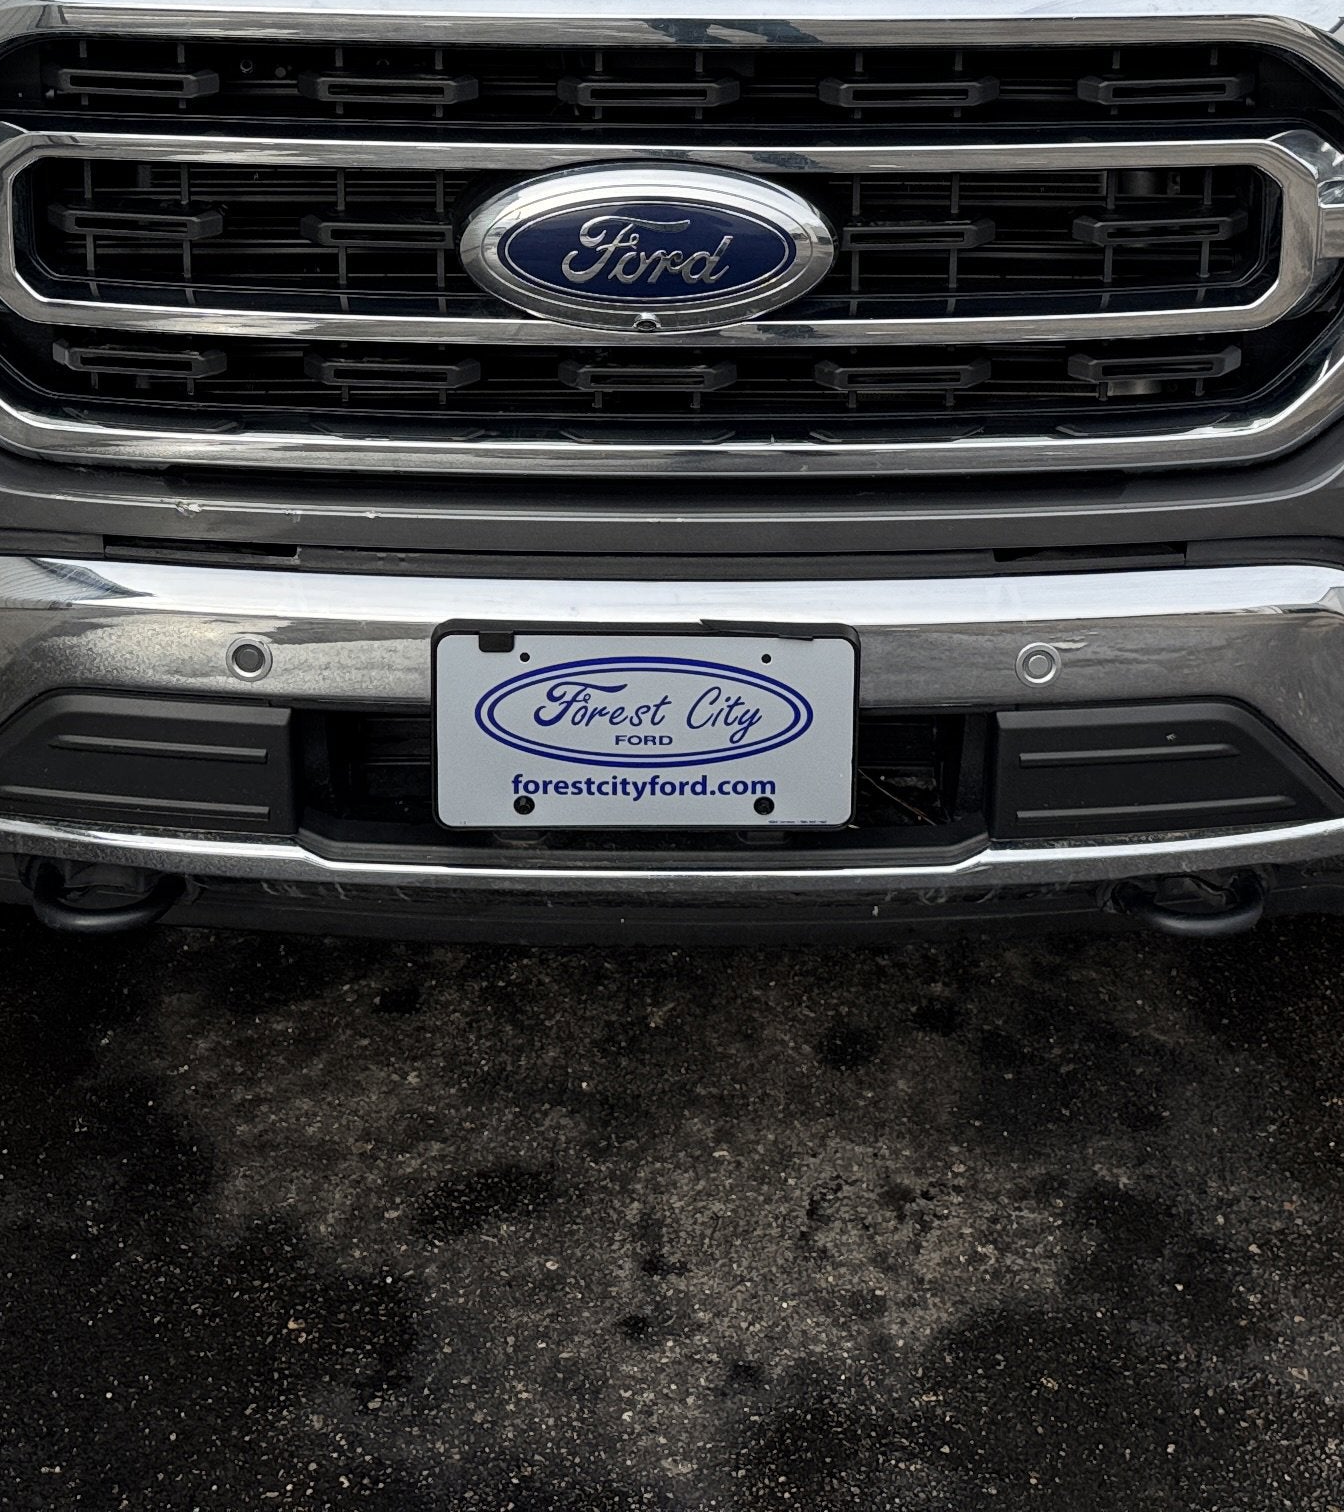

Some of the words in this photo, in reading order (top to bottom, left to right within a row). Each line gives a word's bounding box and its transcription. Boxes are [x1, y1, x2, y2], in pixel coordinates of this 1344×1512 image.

[561, 214, 734, 285] Ford
[533, 681, 673, 727] Forest
[686, 686, 763, 744] City
[614, 734, 674, 746] FORD
[511, 773, 777, 801] forestcityford.com
